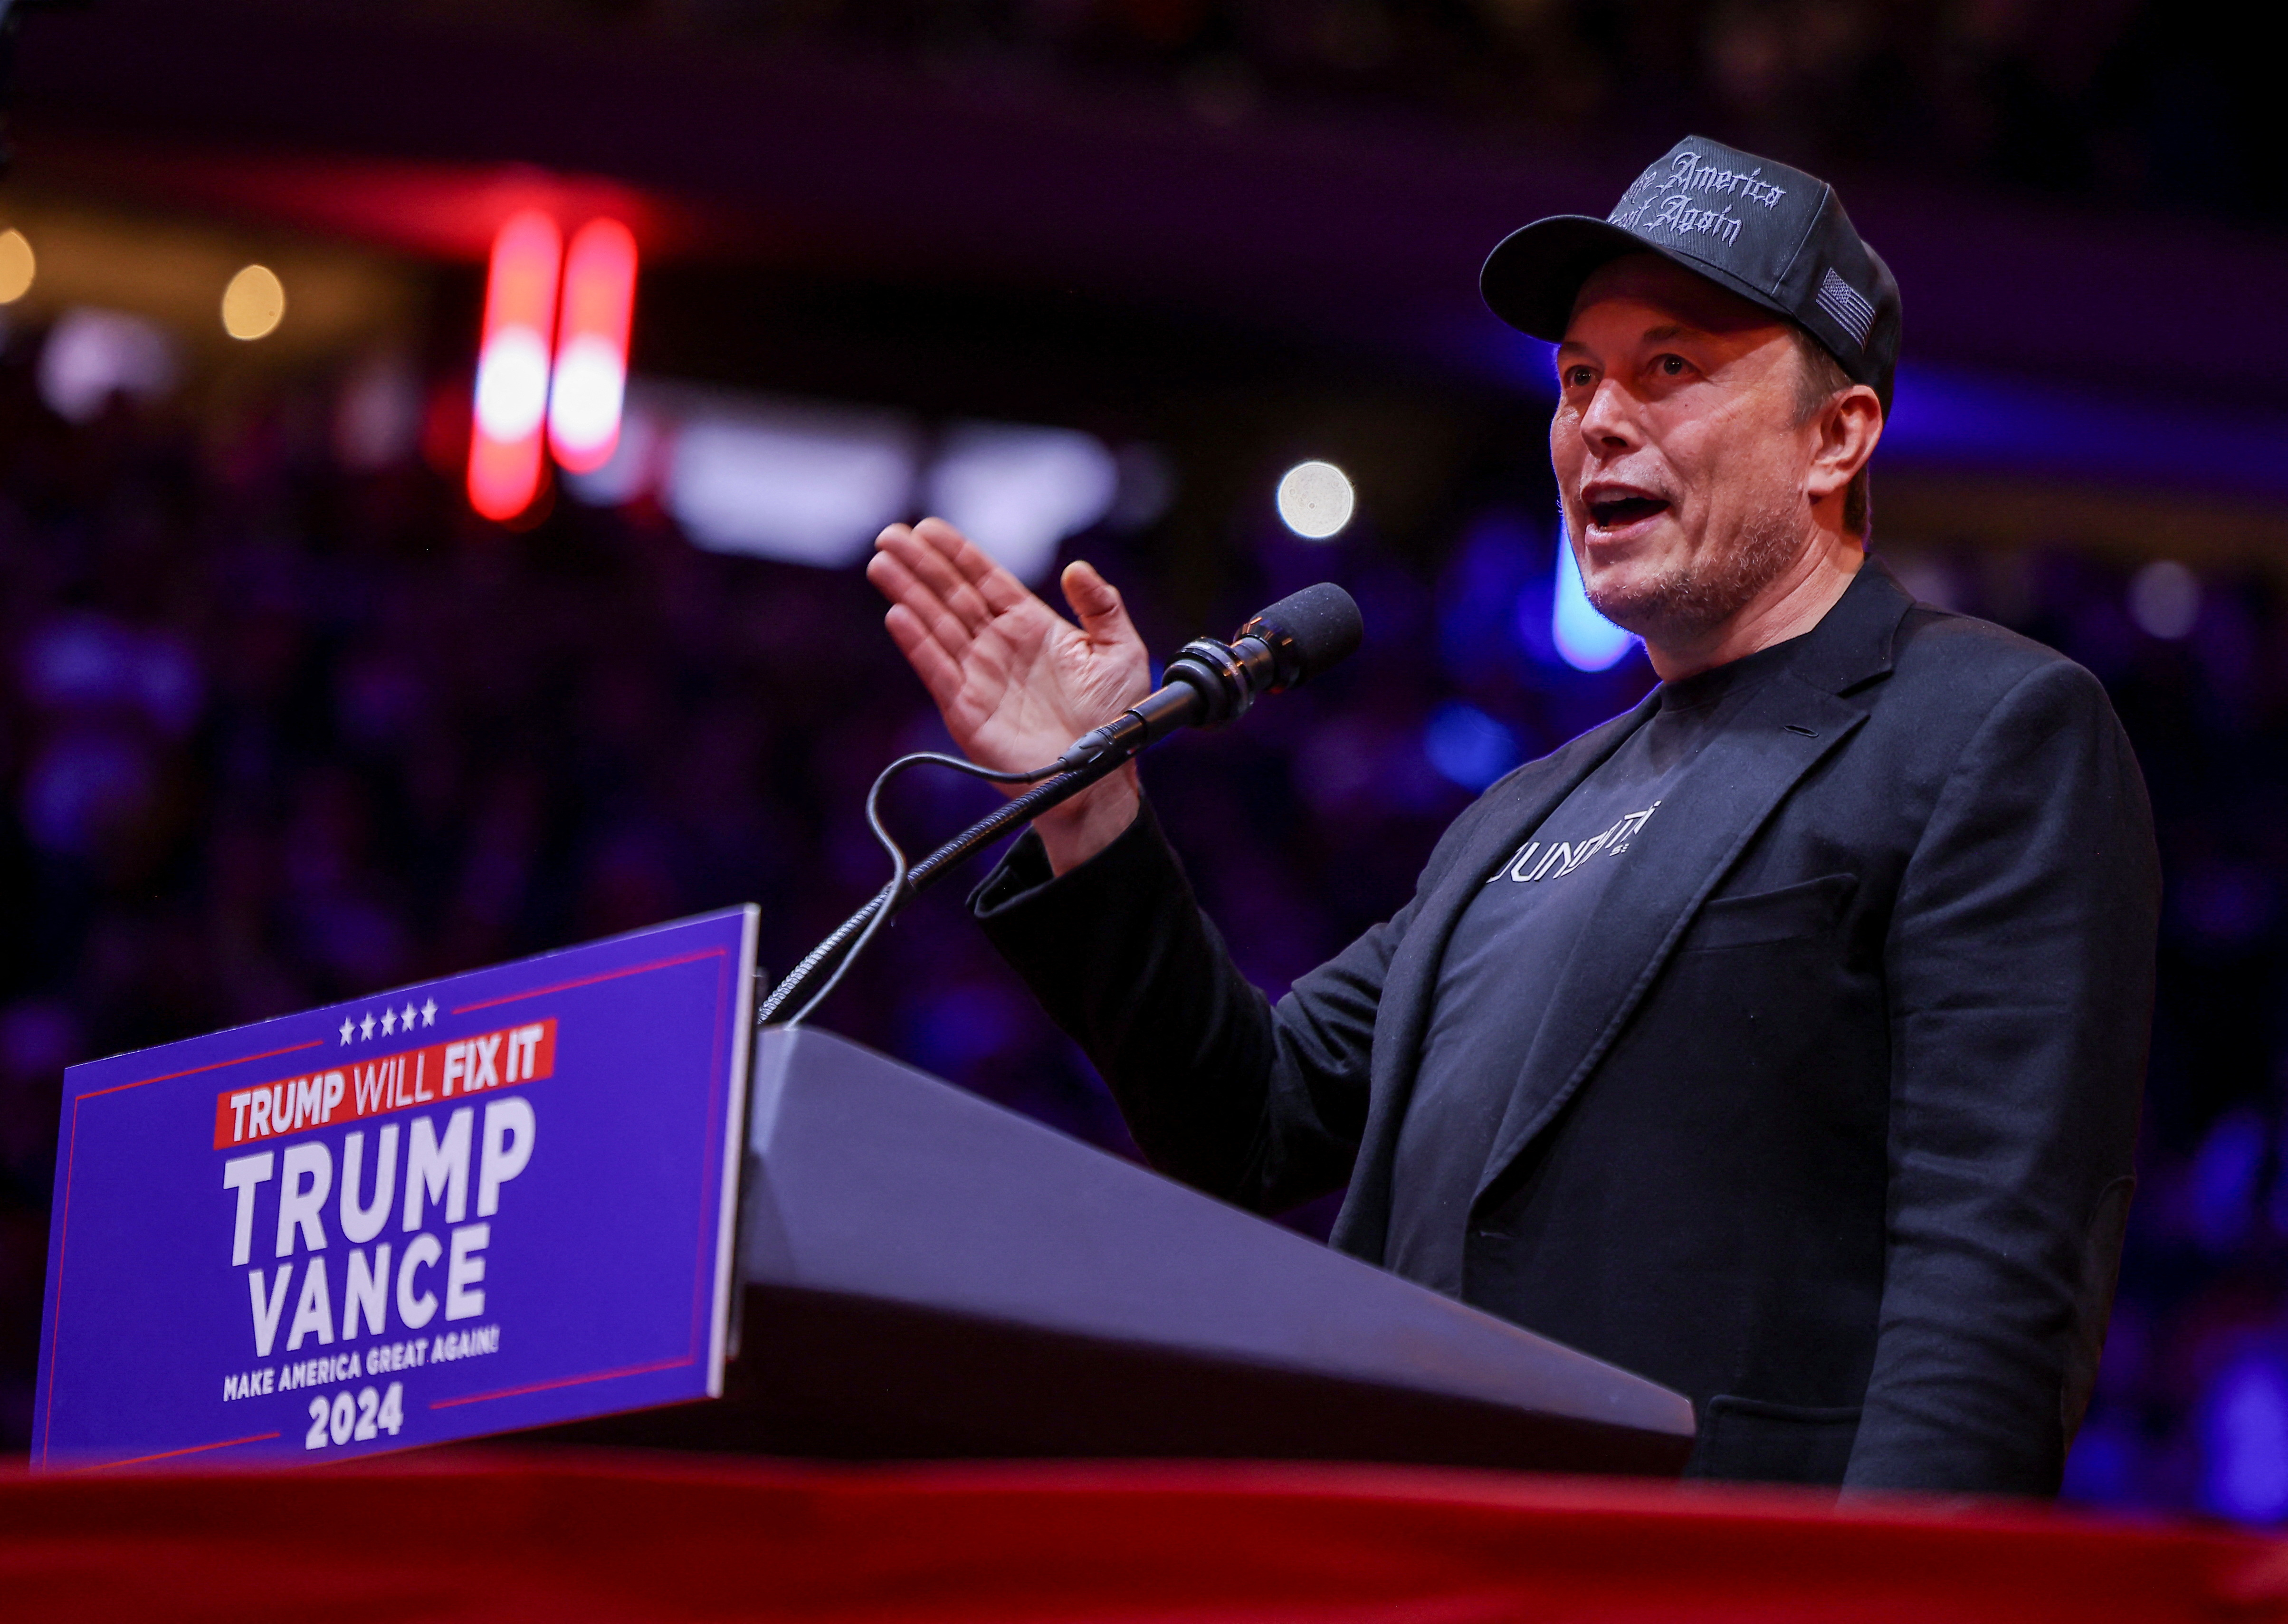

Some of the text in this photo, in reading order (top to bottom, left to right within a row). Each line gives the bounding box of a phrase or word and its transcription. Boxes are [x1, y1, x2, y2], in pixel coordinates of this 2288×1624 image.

[1656, 152, 1787, 210] America
[1643, 194, 1744, 248] Again
[230, 1024, 544, 1142] TRUMP WILL FIX IT
[223, 1096, 537, 1267] TRUMP
[248, 1222, 491, 1357] VANCE
[223, 1324, 500, 1402] MAKE AMERICA GREAT AGAIN!
[305, 1381, 404, 1451] 2024
